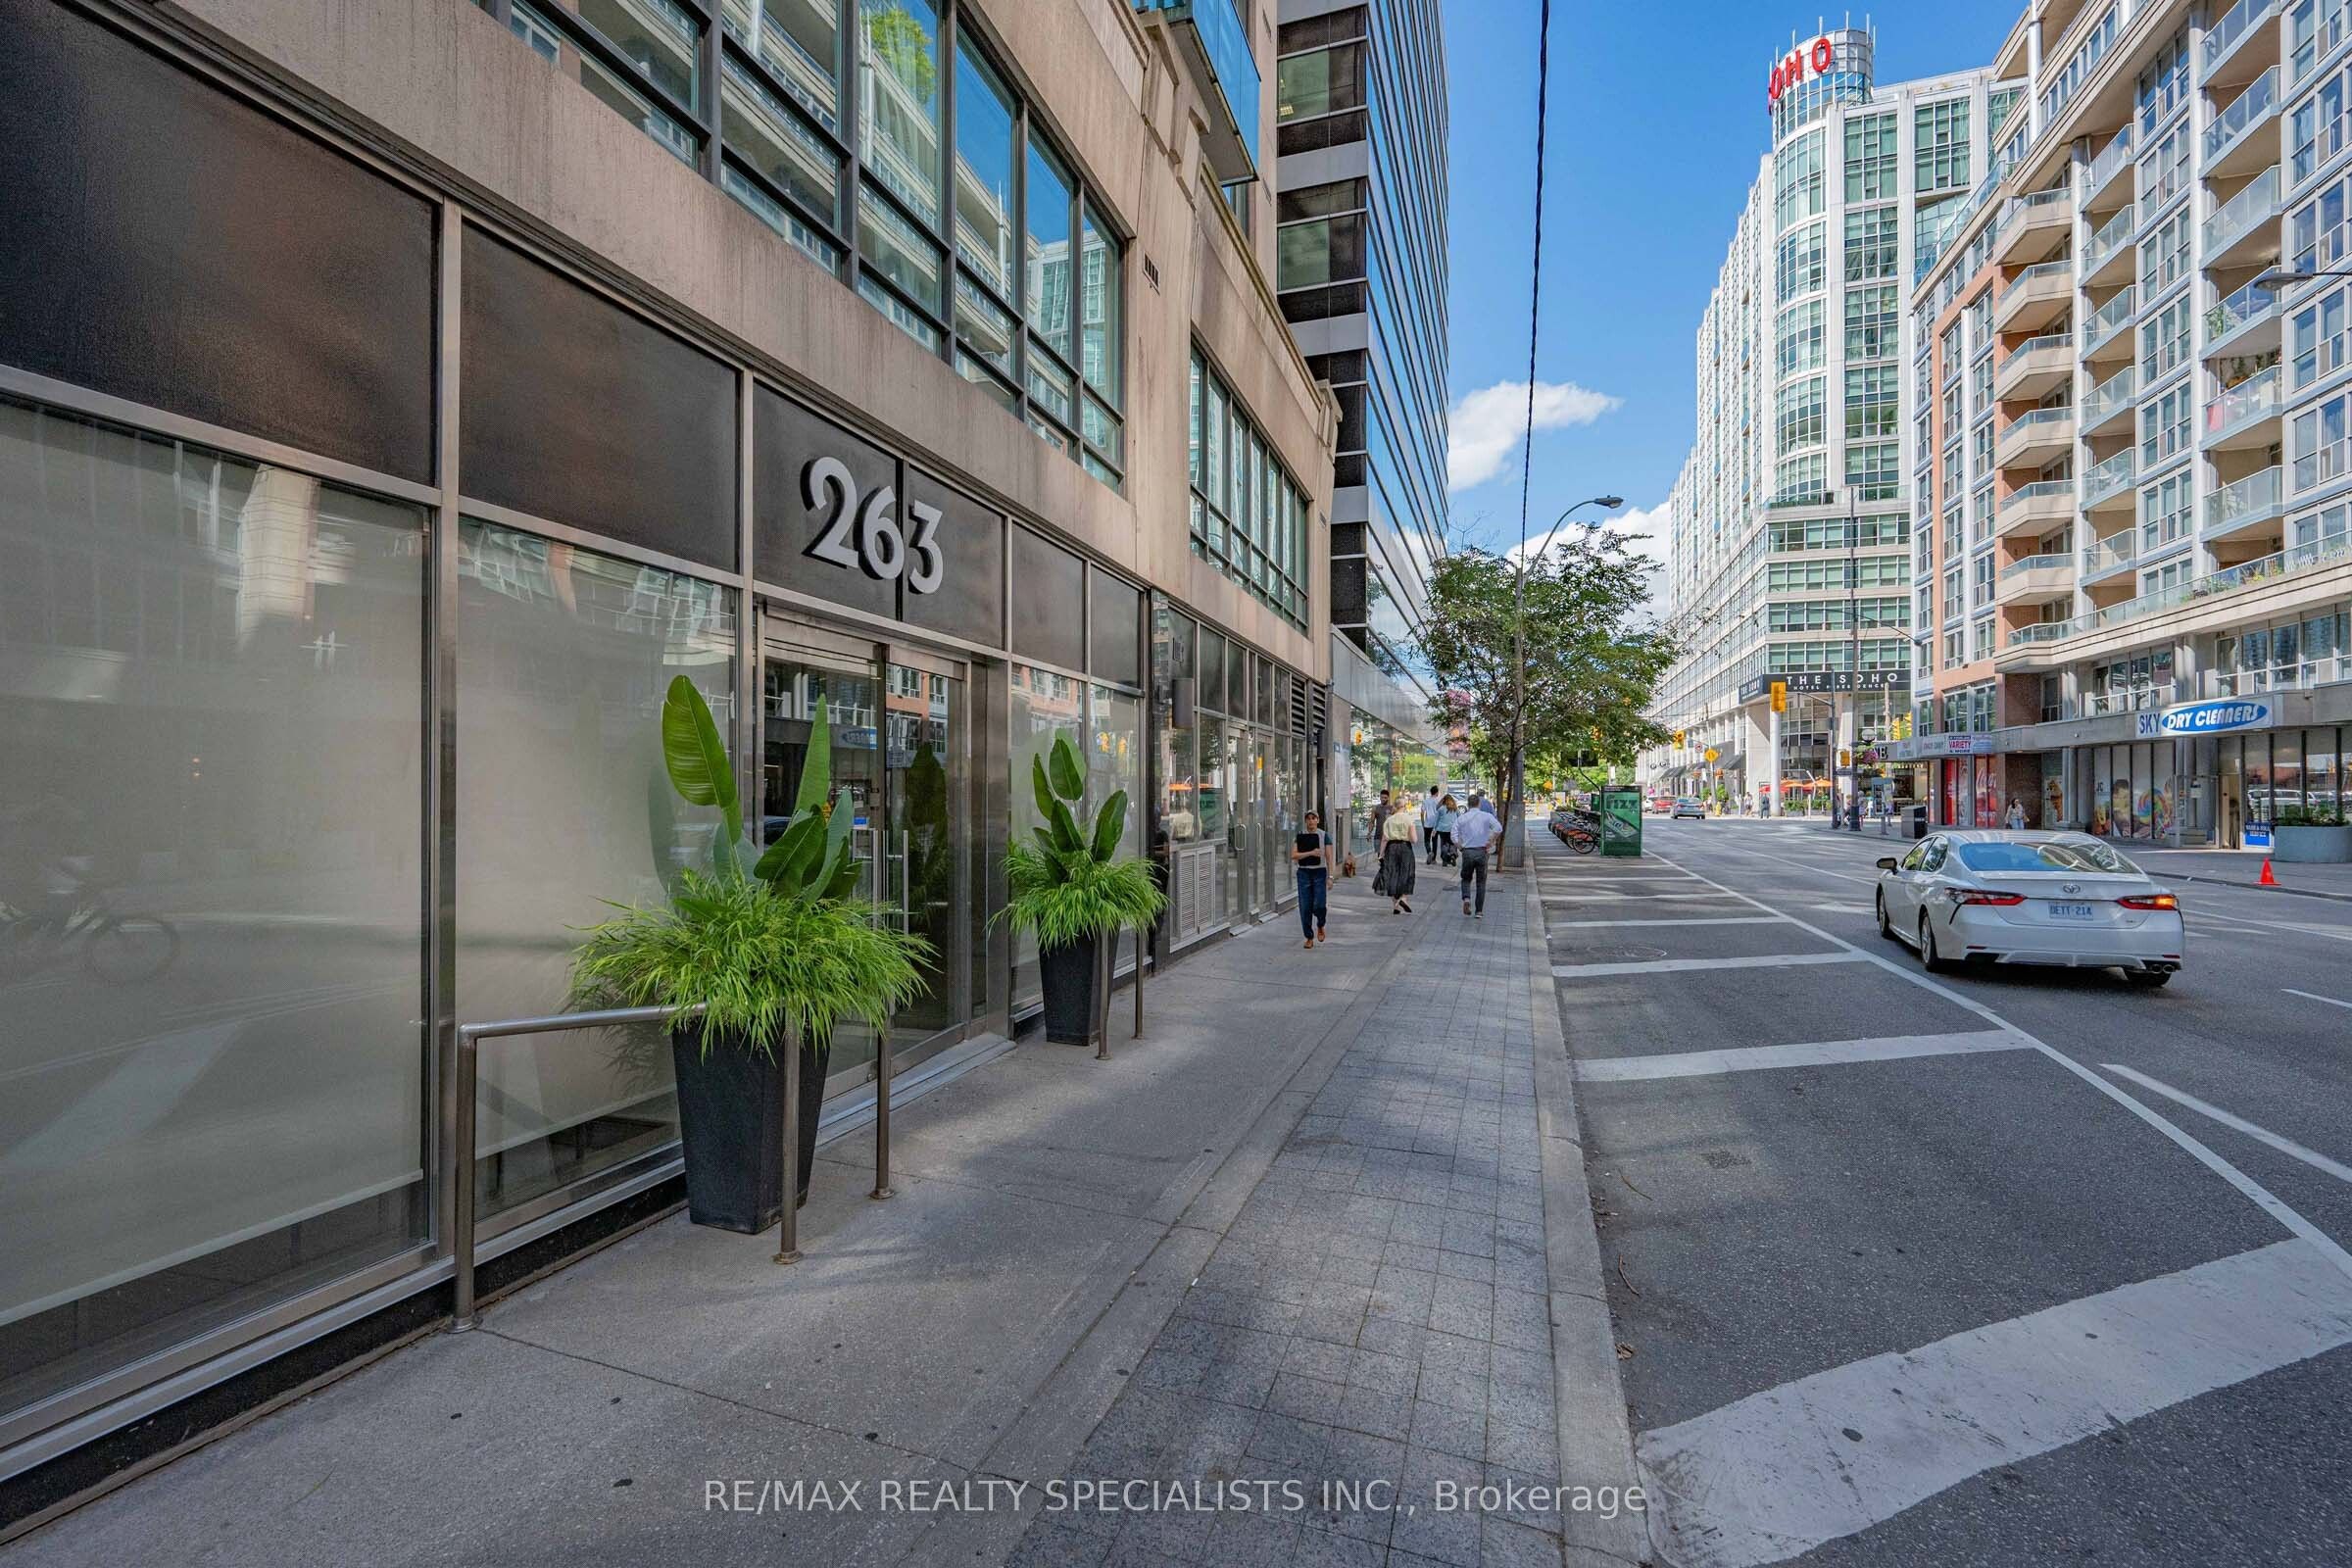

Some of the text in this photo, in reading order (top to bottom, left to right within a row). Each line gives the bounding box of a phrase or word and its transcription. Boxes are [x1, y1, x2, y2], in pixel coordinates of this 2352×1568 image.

[1768, 36, 1832, 115] OHO
[800, 457, 944, 595] 263
[1787, 672, 1898, 685] THE SOHO
[2138, 705, 2259, 734] SKY DRY CLEANERS
[1948, 740, 1971, 750] VARIETY
